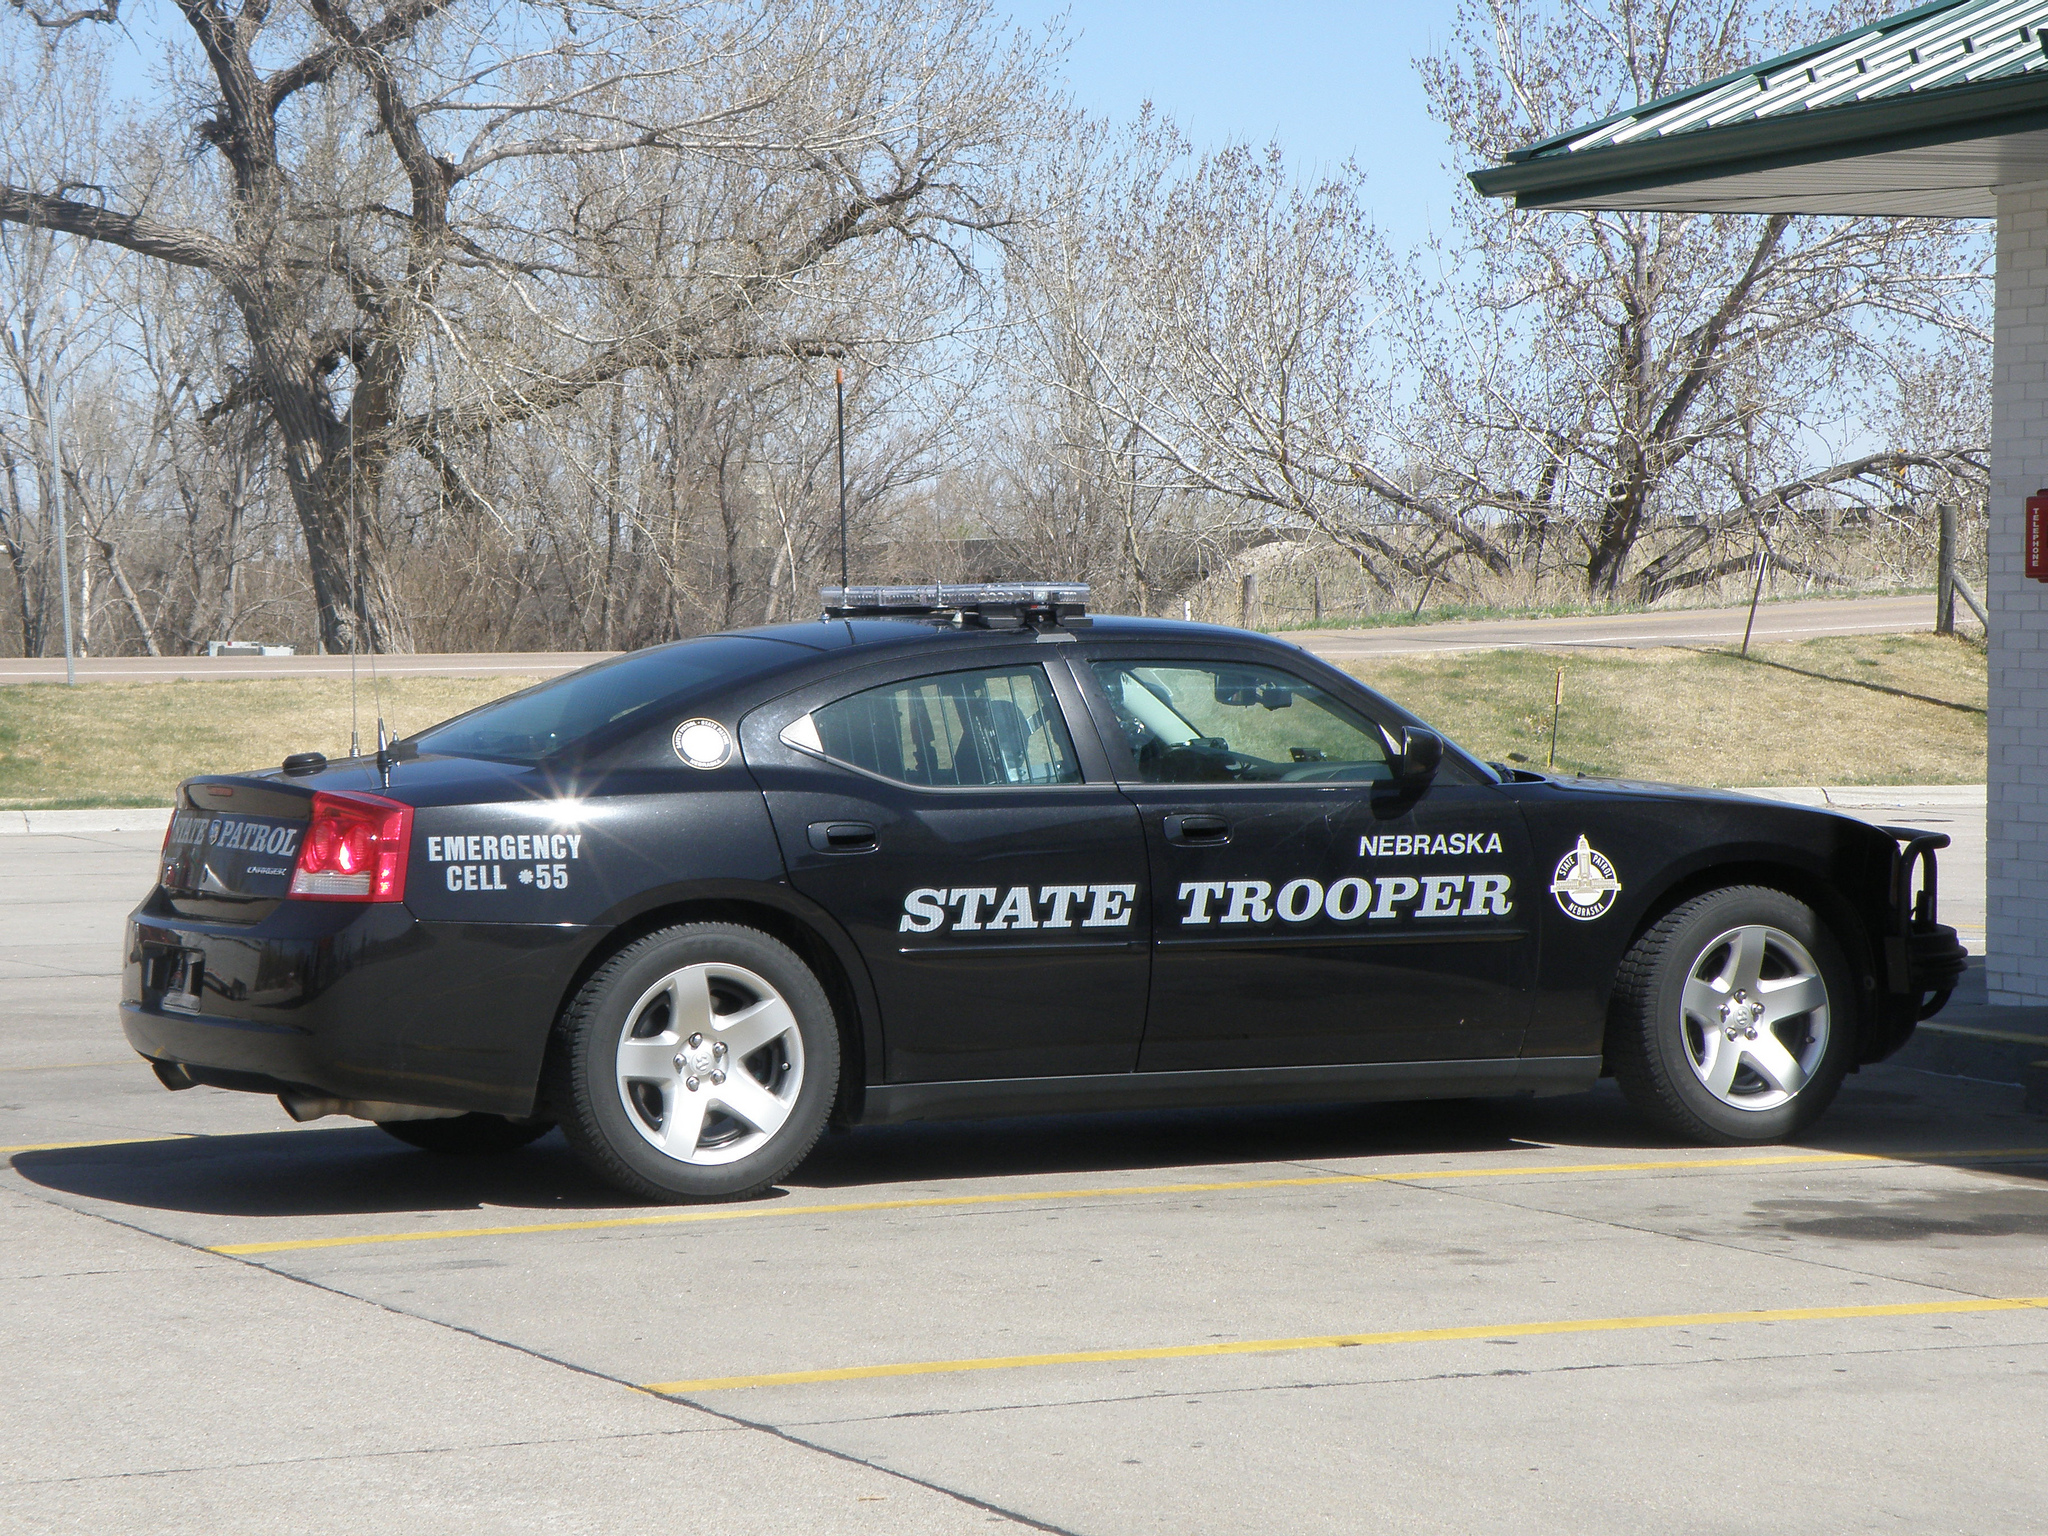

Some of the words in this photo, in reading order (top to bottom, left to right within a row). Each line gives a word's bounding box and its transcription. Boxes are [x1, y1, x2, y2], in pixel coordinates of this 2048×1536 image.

[2032, 507, 2040, 567] TELEPHONE
[216, 820, 298, 857] PATROL
[427, 834, 582, 862] EMERGENCY
[1359, 833, 1503, 856] NEBRASKA
[446, 865, 507, 892] CELL
[1558, 856, 1576, 876] STATE
[1592, 854, 1613, 879] PATROL
[899, 884, 1136, 933] STATE
[1177, 874, 1513, 924] TROOPER
[1568, 902, 1605, 917] NEBRASKA
